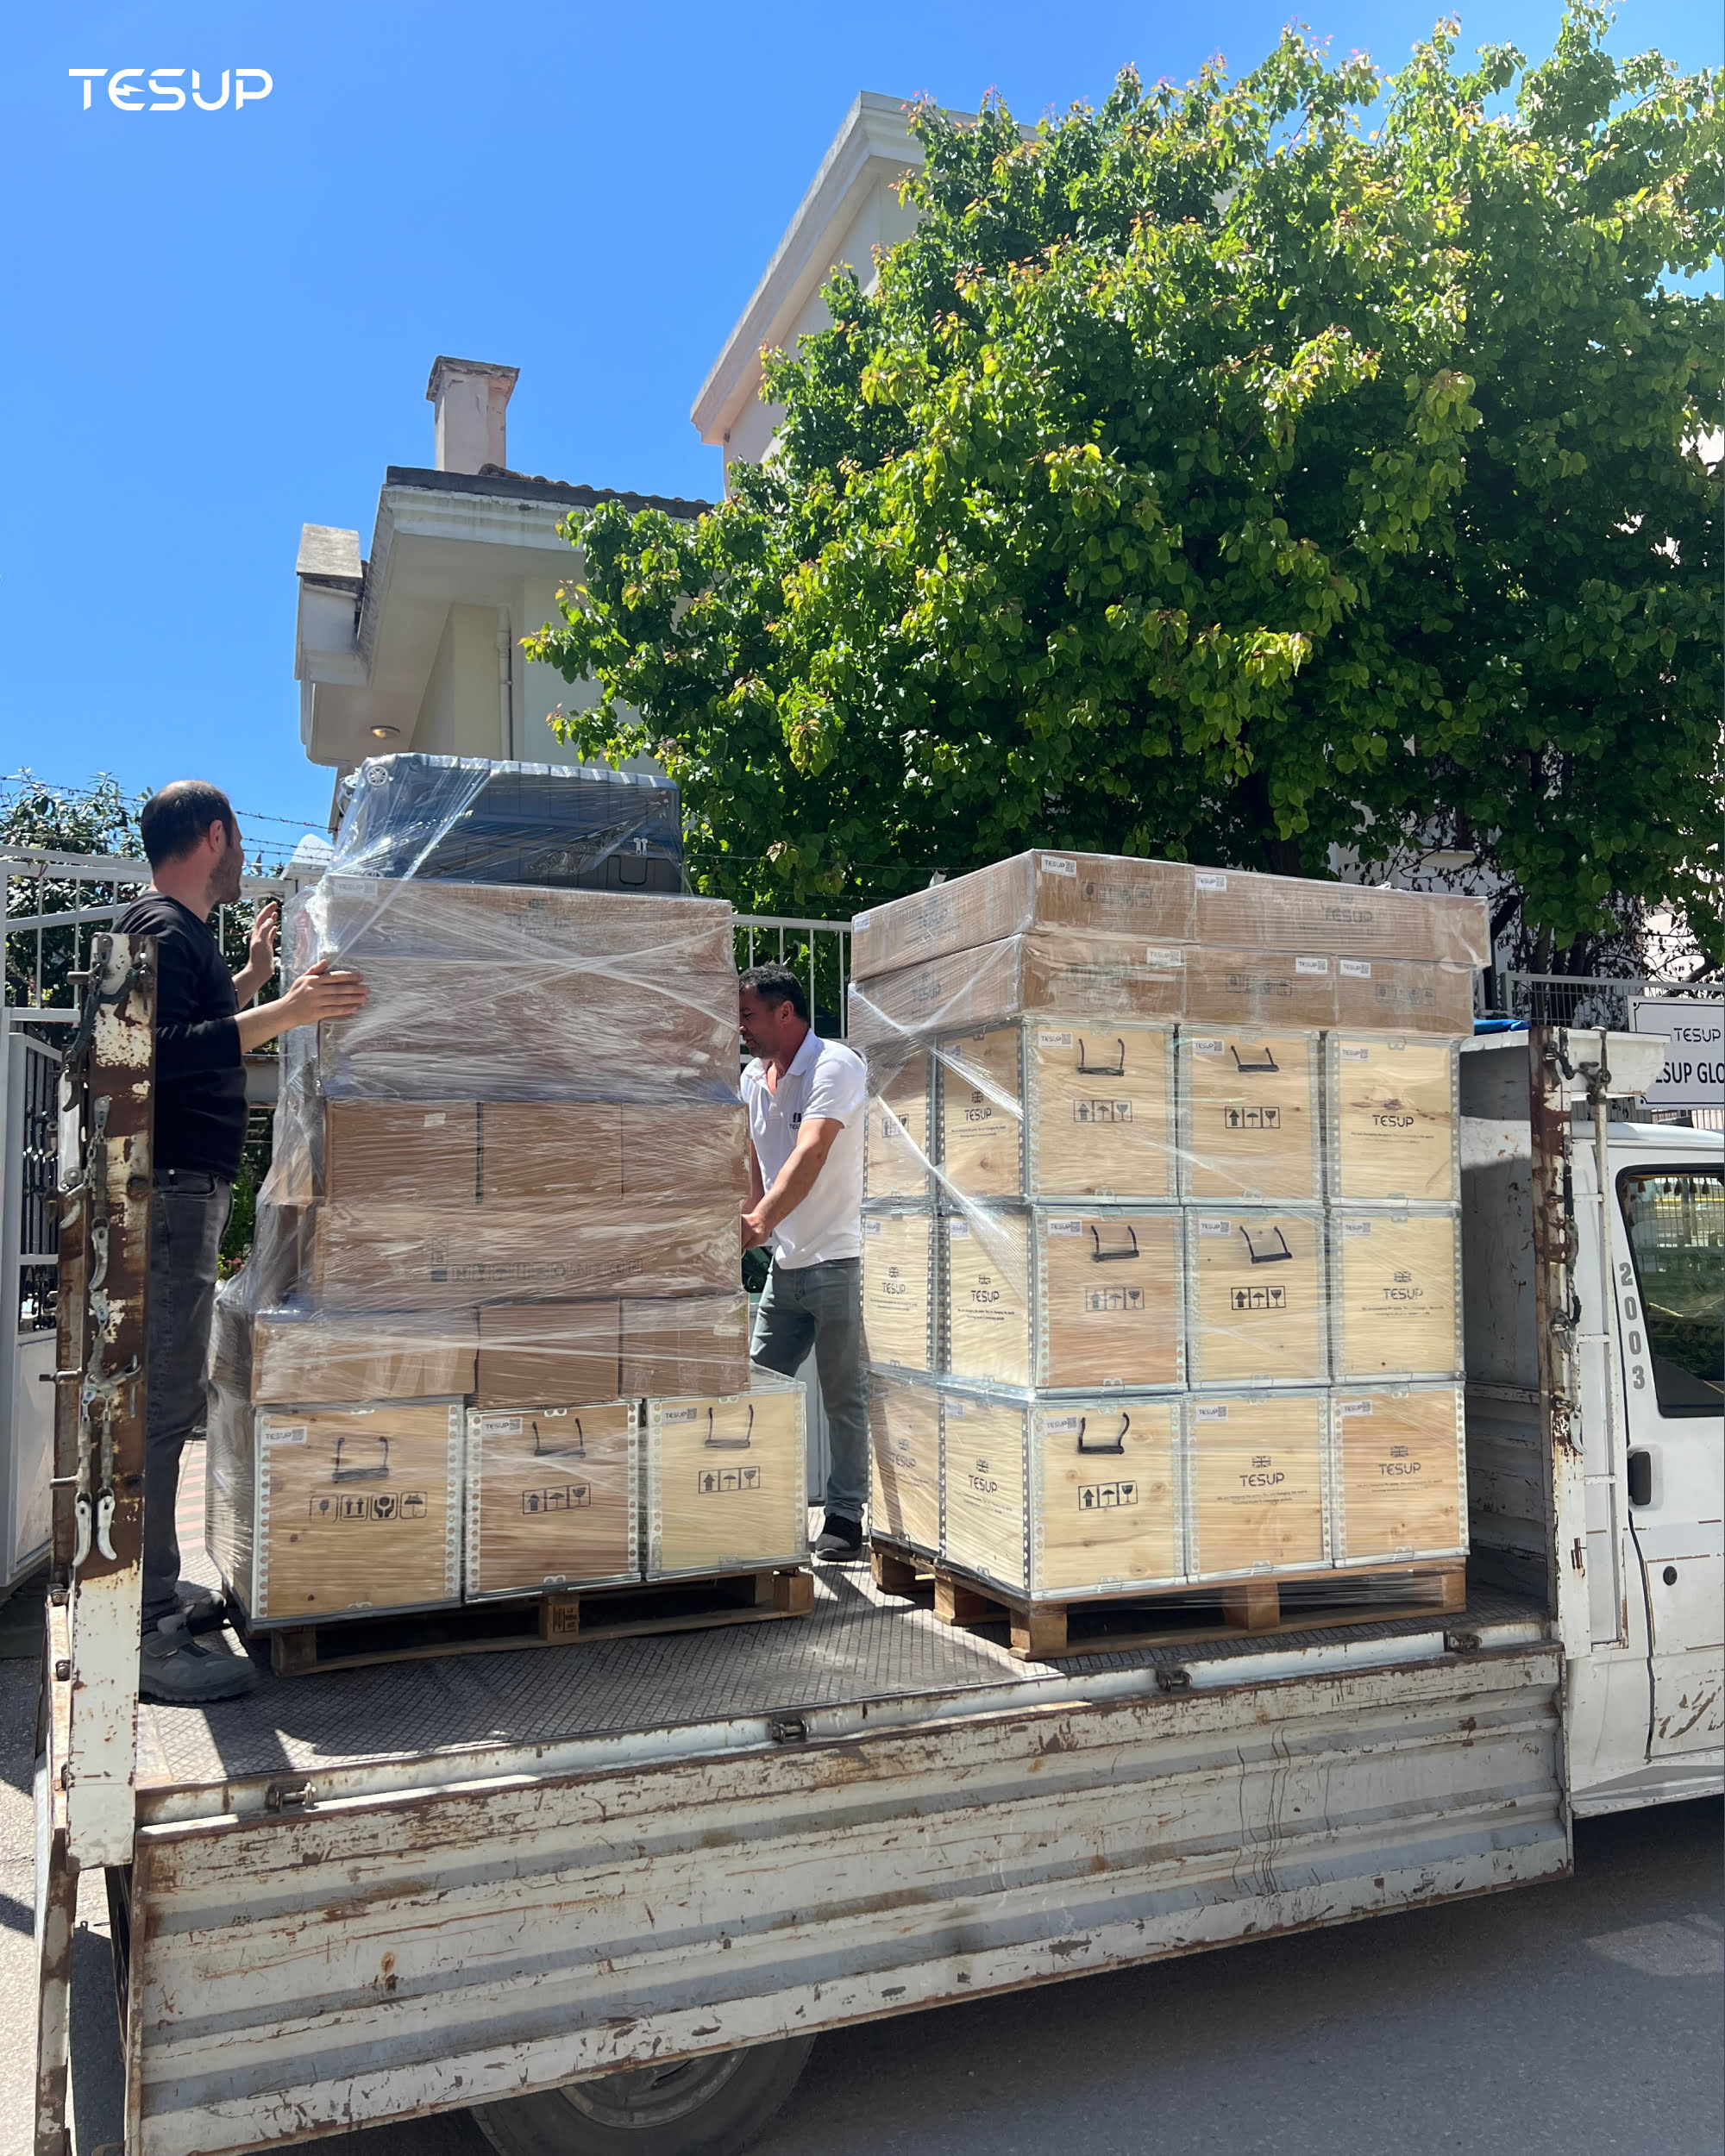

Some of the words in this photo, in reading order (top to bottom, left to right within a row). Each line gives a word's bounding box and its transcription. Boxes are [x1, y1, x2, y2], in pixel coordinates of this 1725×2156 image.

[1044, 859, 1065, 869] TESUP
[1196, 876, 1216, 885] TESUP
[1150, 951, 1170, 960] TESUP
[1673, 1027, 1722, 1043] TESUP
[964, 1107, 992, 1121] TESUP
[1372, 1115, 1414, 1127] TESUP
[881, 1282, 906, 1294] TESUP
[1383, 1288, 1423, 1300] TESUP
[970, 1290, 1000, 1303] TESUP
[1619, 1262, 1646, 1390] 2003
[890, 1452, 916, 1468] TESUP
[1378, 1462, 1421, 1476] TESUP
[968, 1475, 998, 1494] TESUP
[1239, 1472, 1285, 1488] TESUP
